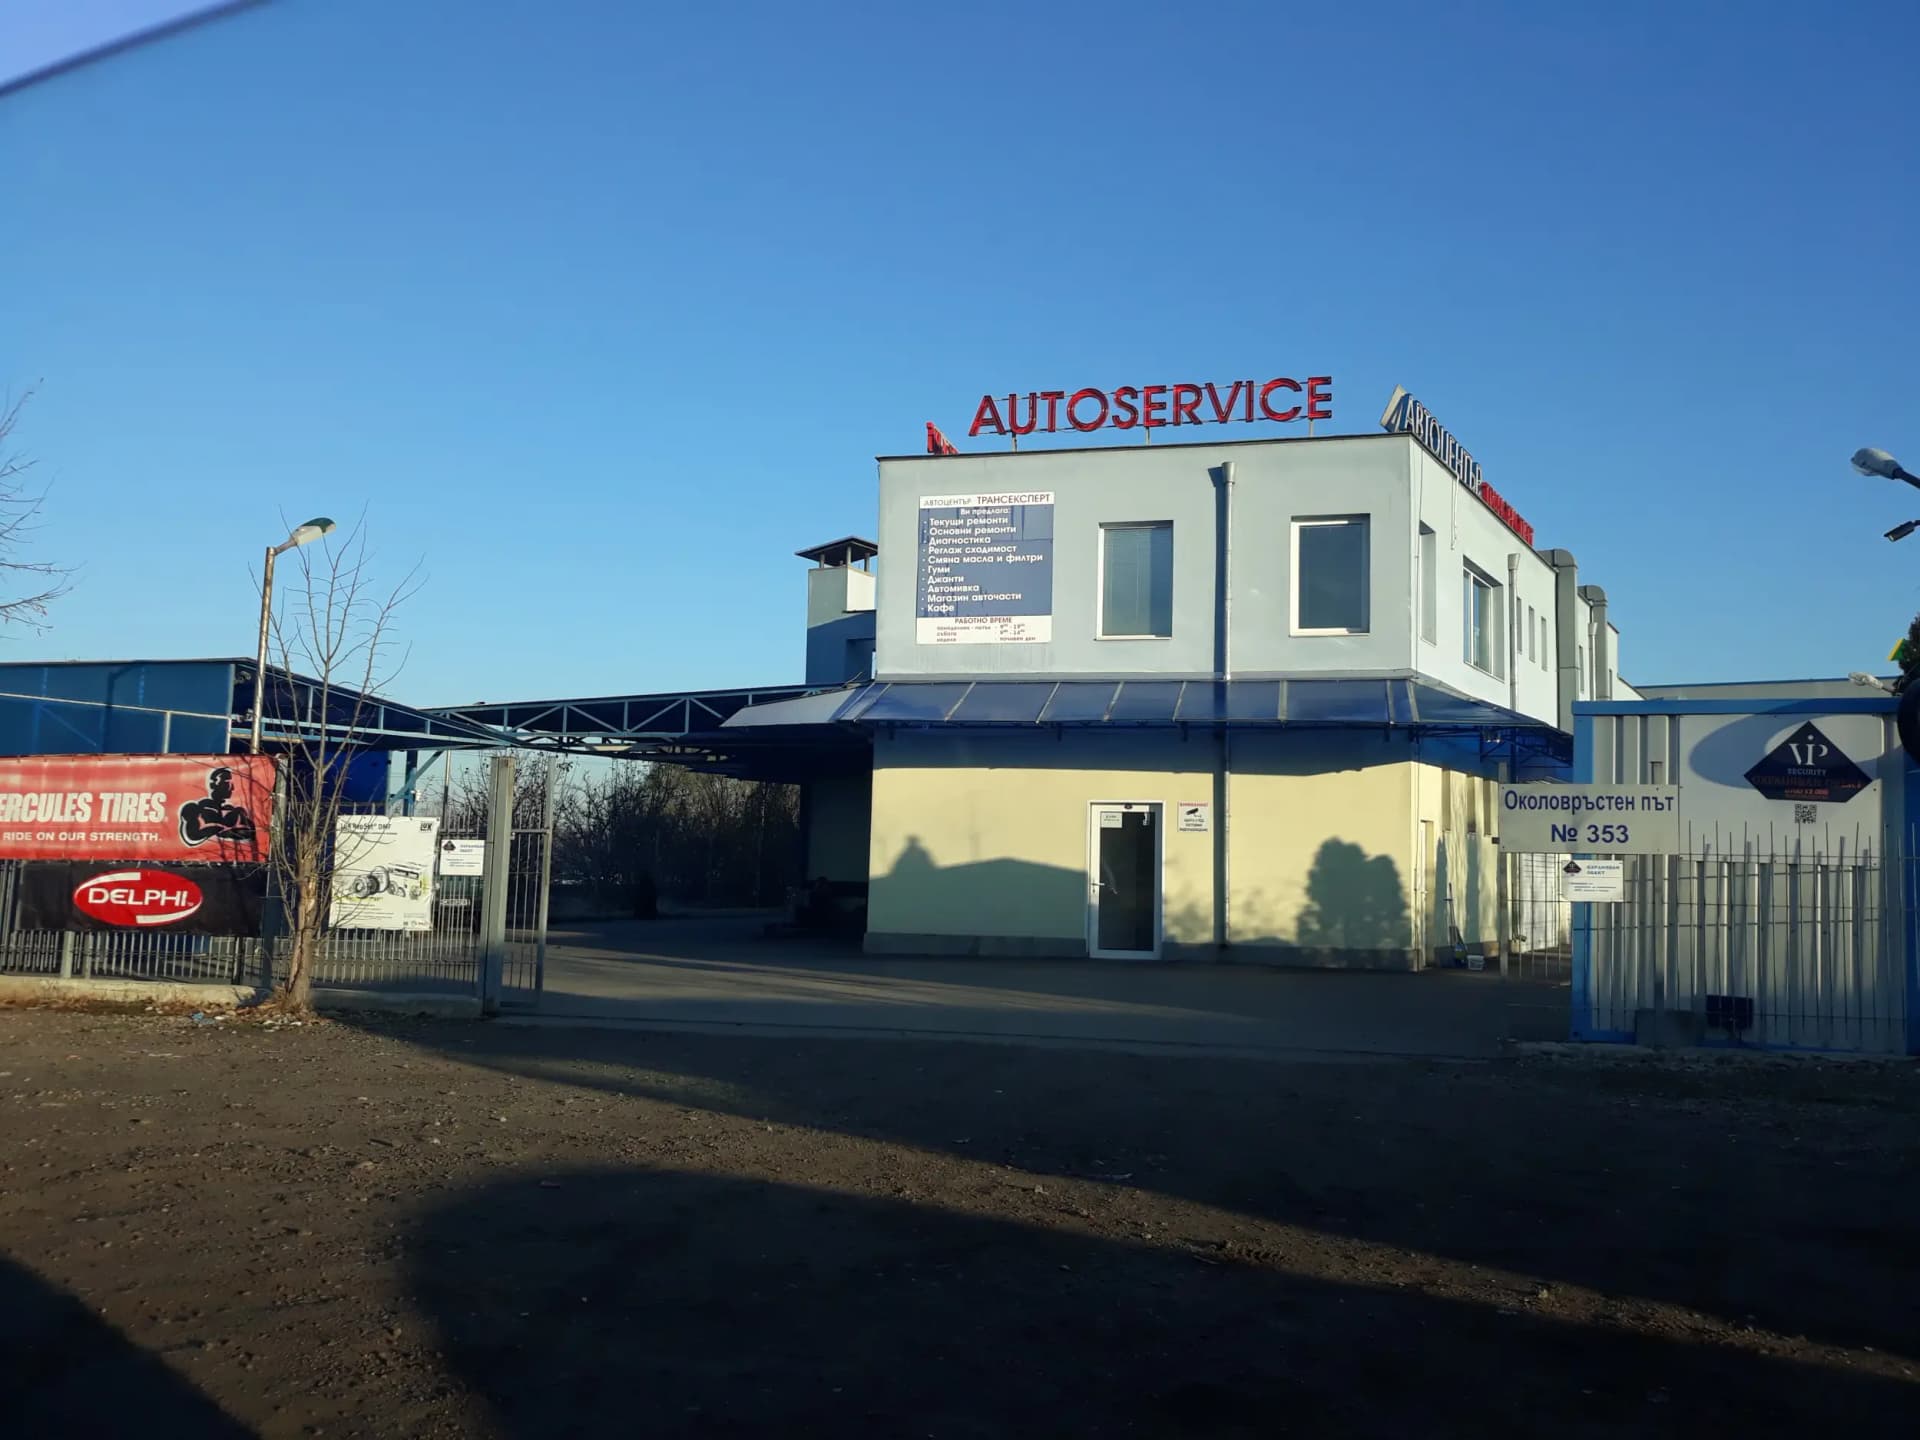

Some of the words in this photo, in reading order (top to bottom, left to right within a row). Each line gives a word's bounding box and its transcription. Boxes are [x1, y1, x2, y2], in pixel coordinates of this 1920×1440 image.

[968, 376, 1333, 436] AUTOSERVICE
[977, 493, 1050, 505] ТРАНСЕКСПЕРТ
[929, 518, 964, 528] Текущи
[967, 517, 1009, 527] ремонти
[929, 527, 972, 536] Основни
[974, 526, 1017, 537] ремонти
[928, 536, 991, 546] Диагностика
[928, 546, 962, 555] Реглаж
[965, 545, 1017, 554] сходимост
[928, 555, 960, 564] Смяна
[963, 555, 994, 563] масла
[1006, 553, 1043, 564] филтри
[927, 565, 950, 575] Гуми
[927, 575, 964, 585] Джанти
[927, 585, 980, 593] Автомивка
[927, 594, 969, 603] Магазин
[972, 593, 1022, 601] авточасти
[927, 604, 955, 613] Кафе
[954, 617, 988, 625] РАБОТНО
[99, 792, 167, 823] TIRES
[1504, 790, 1635, 815] Околовръстен
[1641, 796, 1674, 812] път
[3, 831, 32, 841] RIDE
[36, 831, 55, 841] ON
[58, 831, 86, 841] OUR
[1587, 824, 1629, 843] 353
[88, 888, 188, 908] DELPHI
